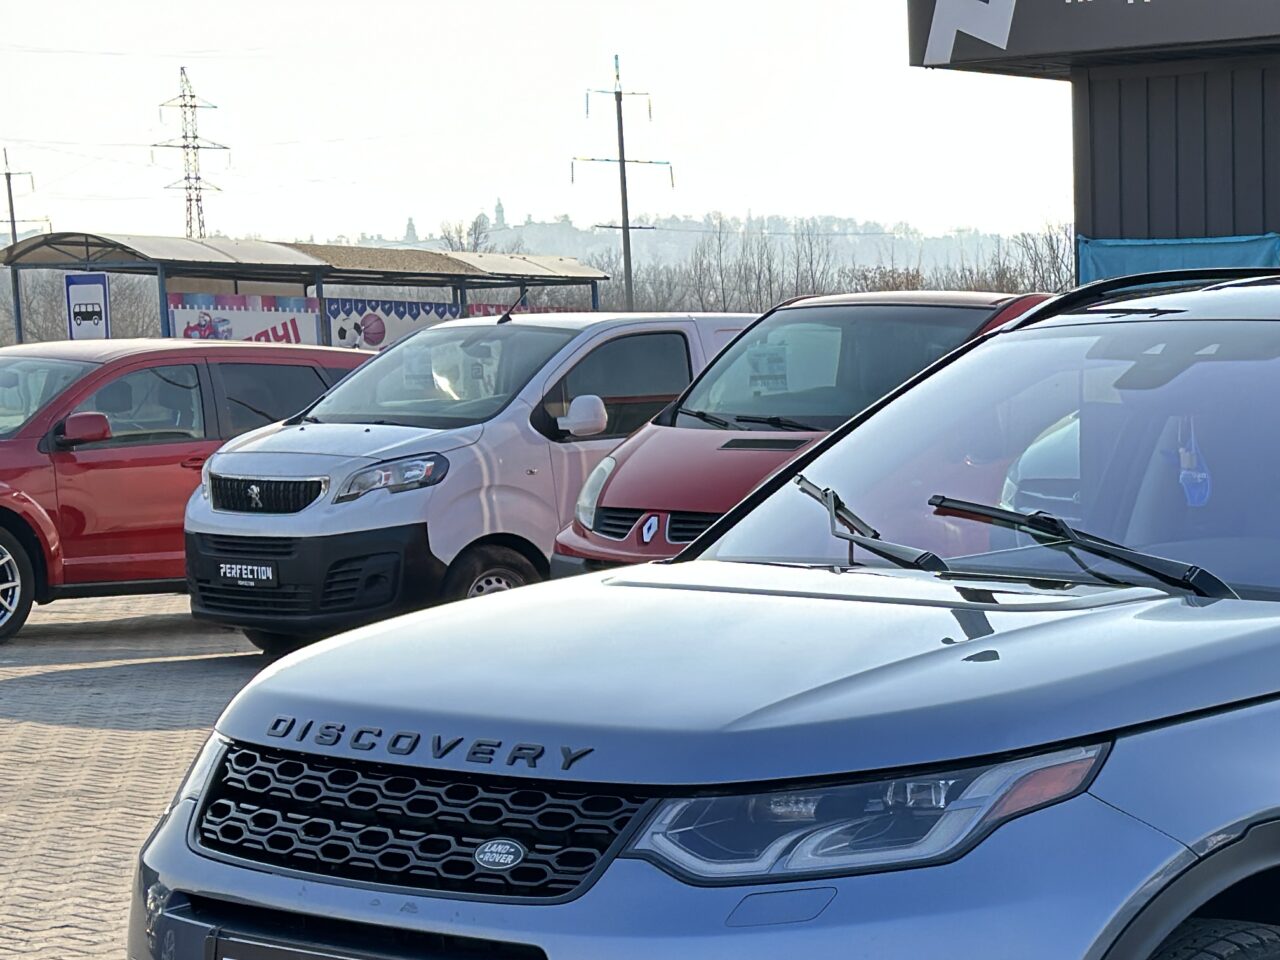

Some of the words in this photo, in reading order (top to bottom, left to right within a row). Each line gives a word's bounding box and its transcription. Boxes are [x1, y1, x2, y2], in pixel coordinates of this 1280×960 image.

[219, 563, 273, 580] PERFECTION
[266, 714, 595, 771] DISCOVERY
[484, 843, 510, 853] LAND
[482, 852, 515, 864] ROVER
